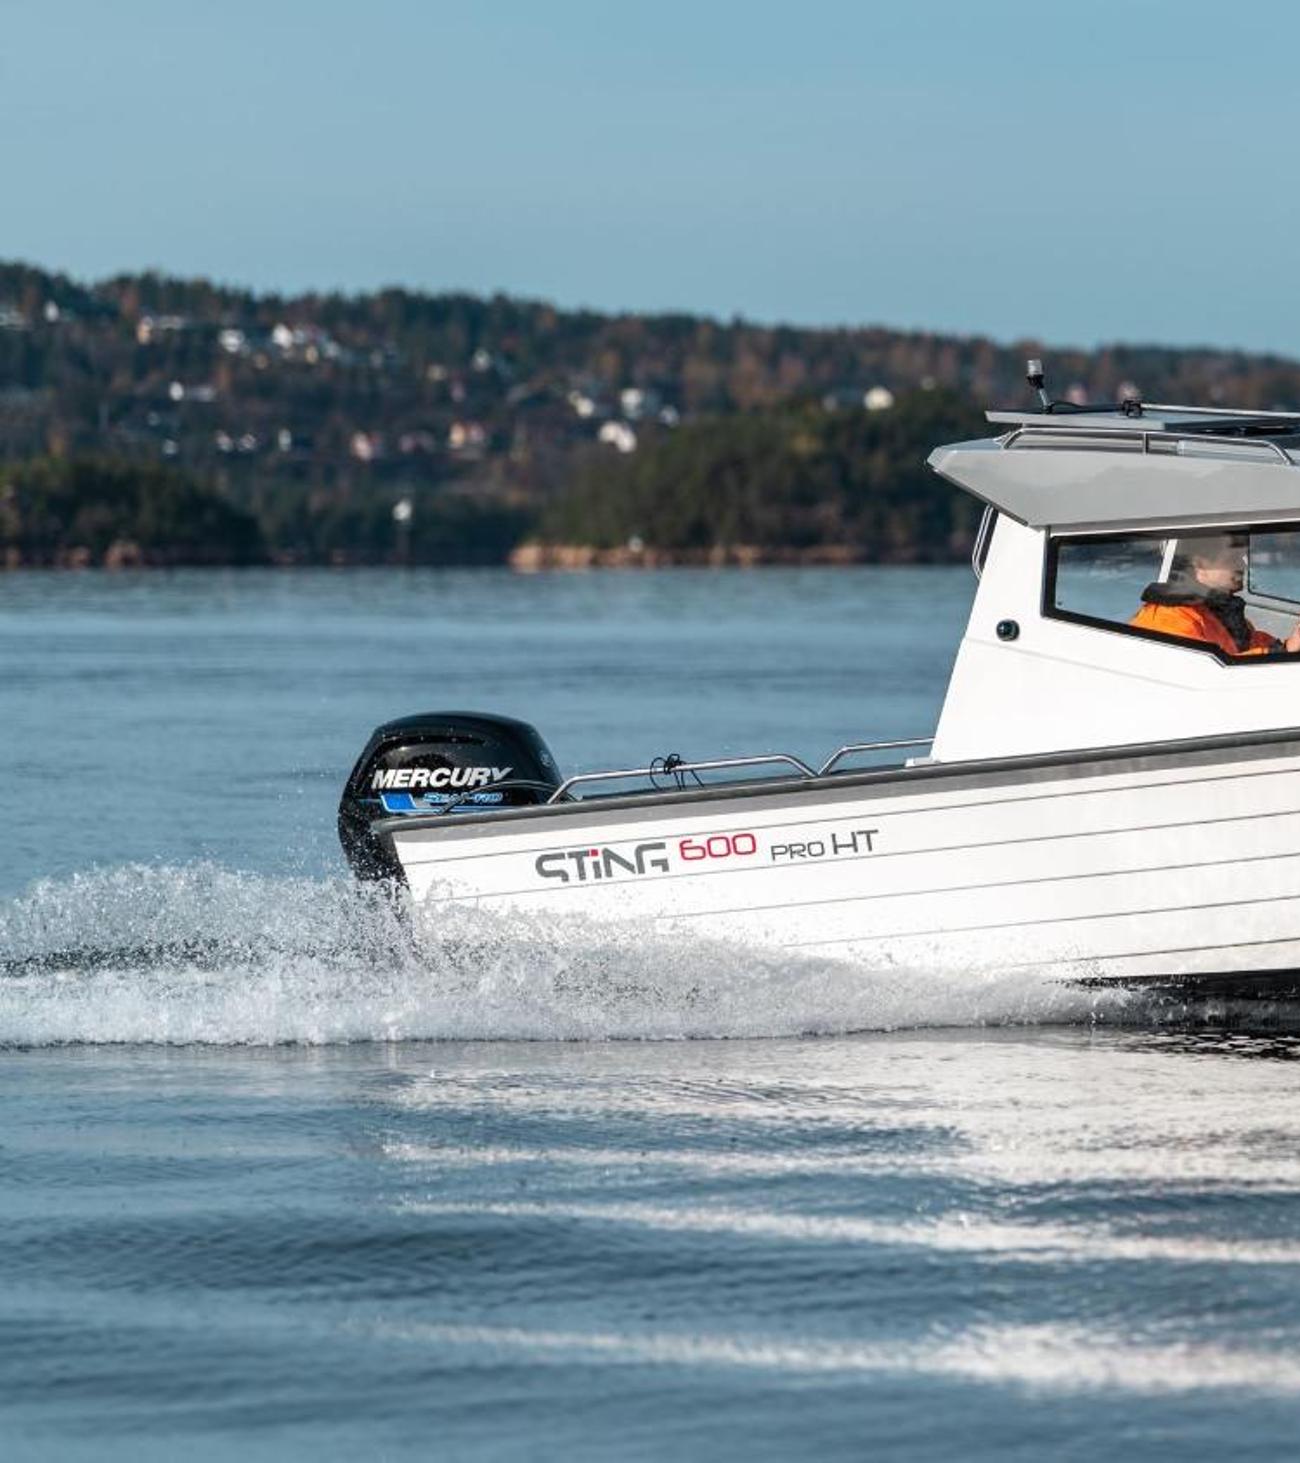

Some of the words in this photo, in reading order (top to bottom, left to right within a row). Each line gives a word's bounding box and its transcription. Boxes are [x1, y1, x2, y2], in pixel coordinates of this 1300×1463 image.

[371, 767, 513, 789] MERCURY
[679, 833, 757, 860] 600
[771, 841, 825, 861] PRO
[831, 829, 879, 855] HT
